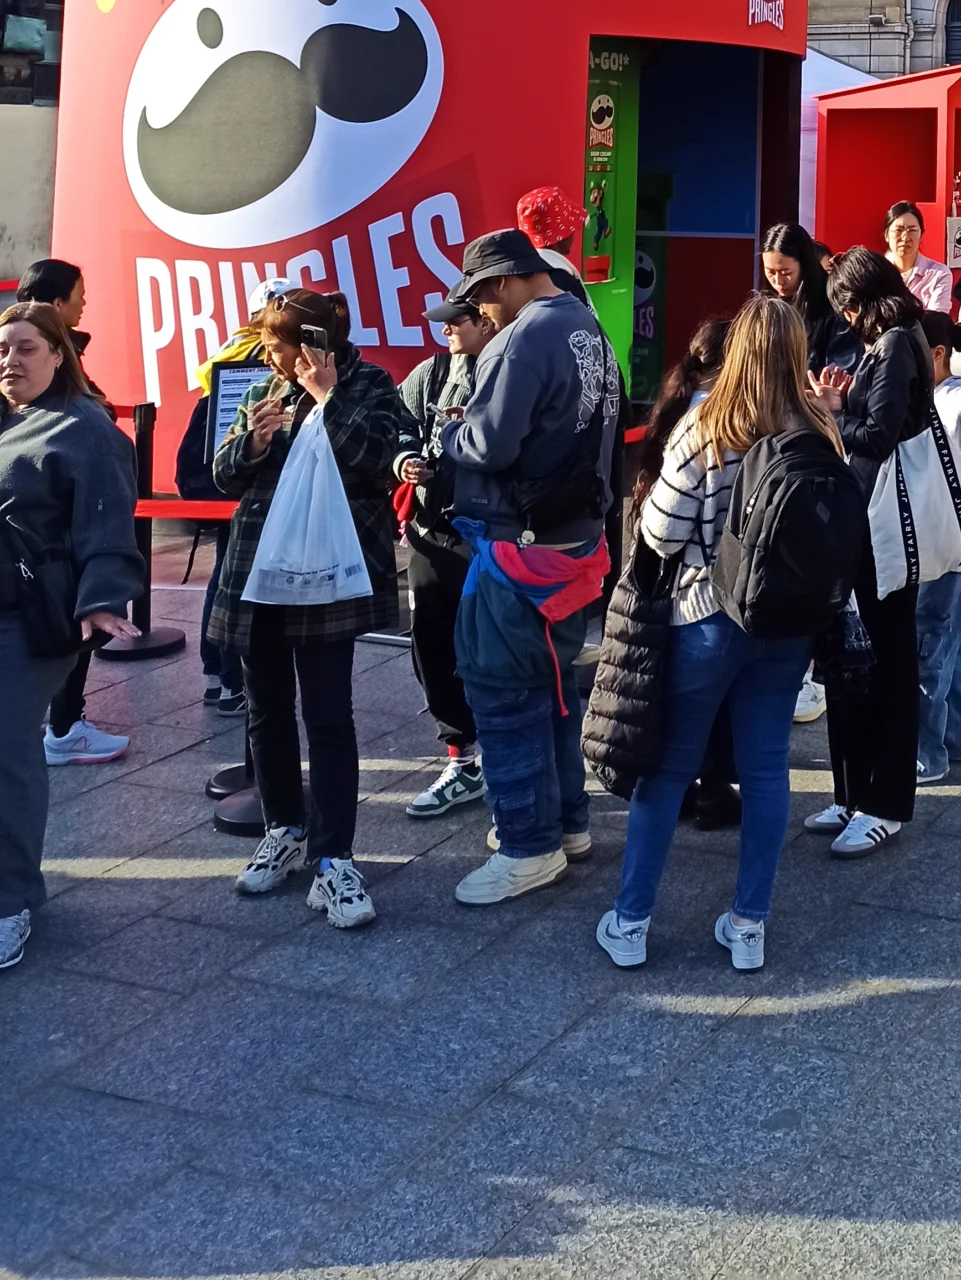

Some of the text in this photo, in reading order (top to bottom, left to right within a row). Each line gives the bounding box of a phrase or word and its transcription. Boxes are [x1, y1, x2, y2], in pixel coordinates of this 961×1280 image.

[589, 127, 614, 148] PRINGLES
[929, 406, 945, 445] JIMMY
[941, 449, 958, 489] FAIRLY
[902, 511, 915, 553] FAIRLY
